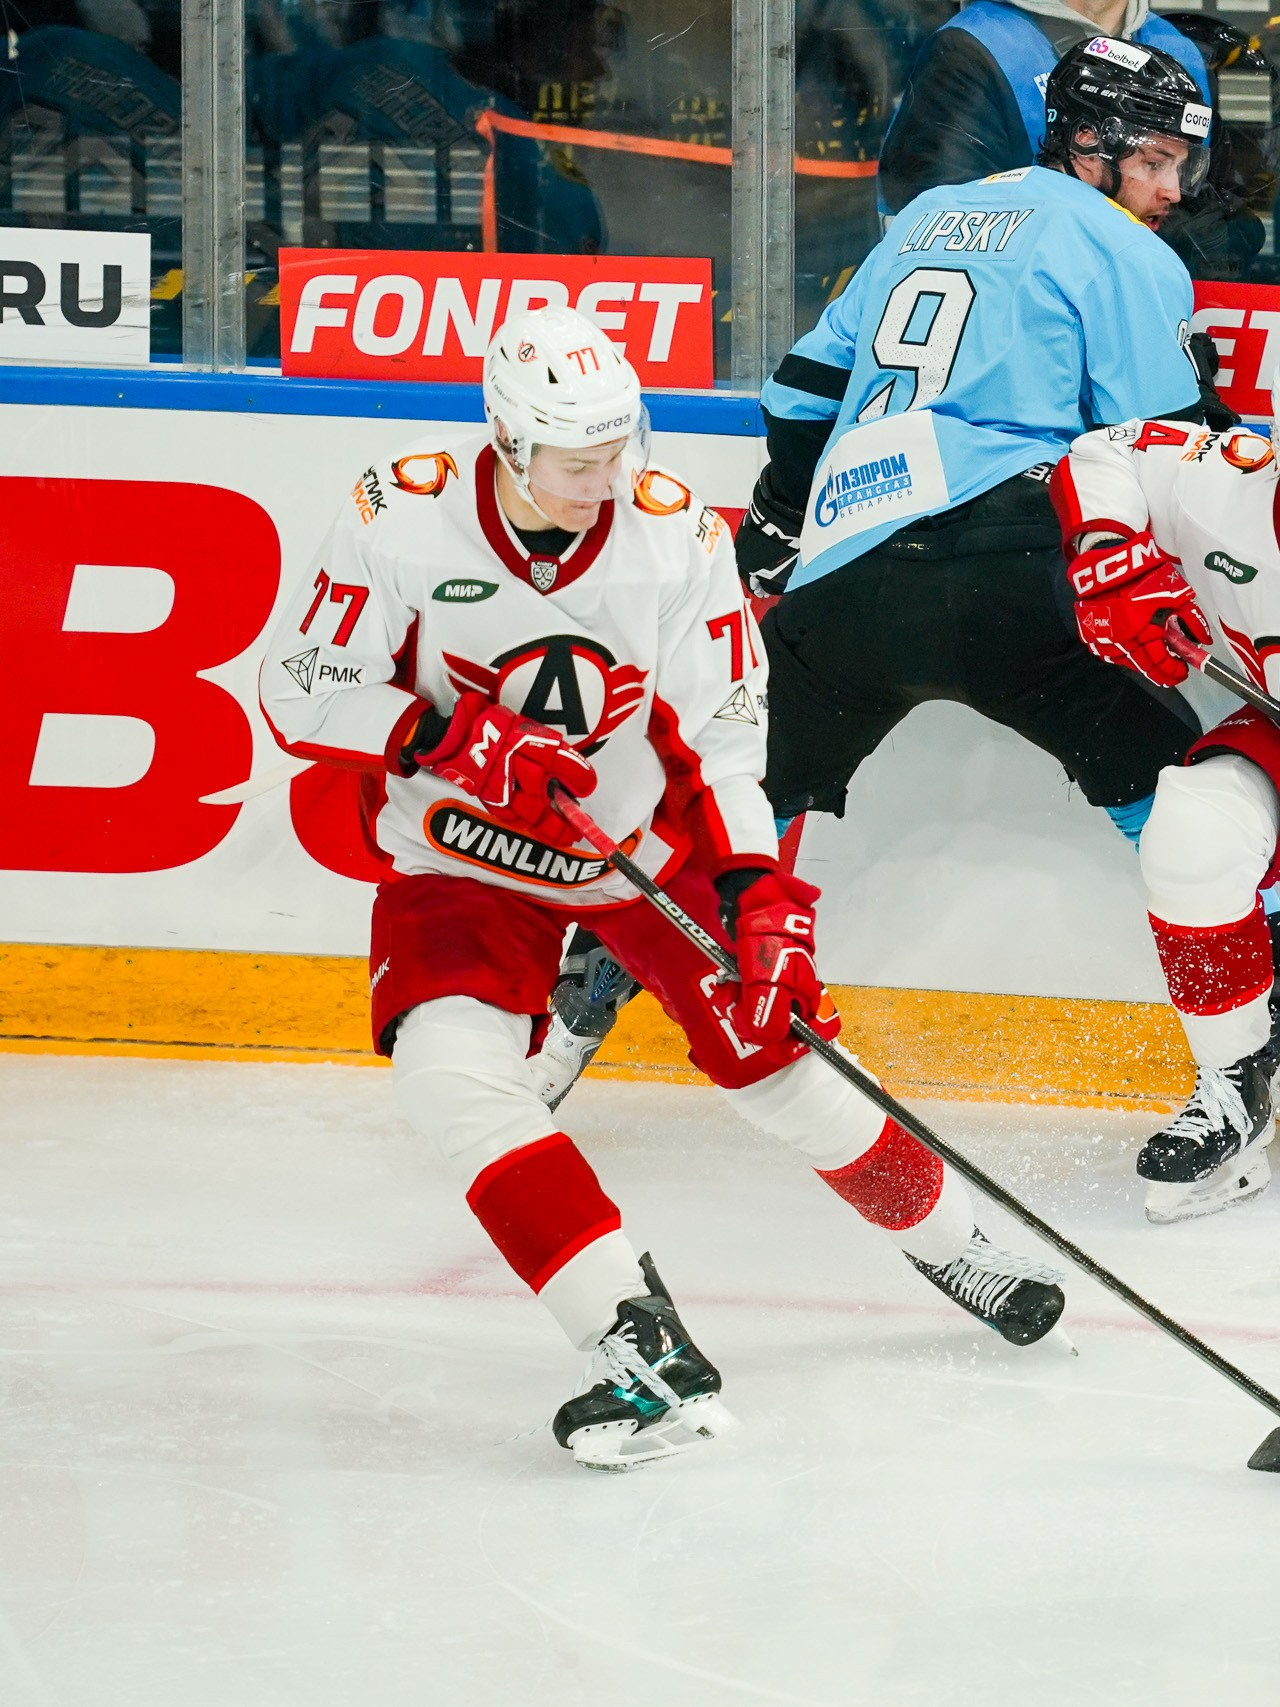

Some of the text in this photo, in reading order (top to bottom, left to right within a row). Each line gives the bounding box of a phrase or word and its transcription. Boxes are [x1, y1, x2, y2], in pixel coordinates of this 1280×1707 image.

[1107, 50, 1141, 70] belbet
[897, 207, 1034, 257] LIPSKY
[566, 347, 600, 376] 77
[871, 266, 977, 424] 9
[585, 413, 631, 436] согаз
[835, 453, 909, 495] ГАЗПРОМ
[837, 475, 912, 508] ТРАНСГАЗ
[839, 487, 914, 519] БЕЛАРУСЬ
[1072, 538, 1162, 595] CCM
[1213, 554, 1244, 578] МИР
[299, 568, 370, 647] 77
[444, 584, 485, 598] МИР
[318, 664, 363, 684] РМК
[442, 812, 606, 884] WINLINE
[653, 890, 718, 950] SOYUZ
[752, 995, 766, 1028] CCM
